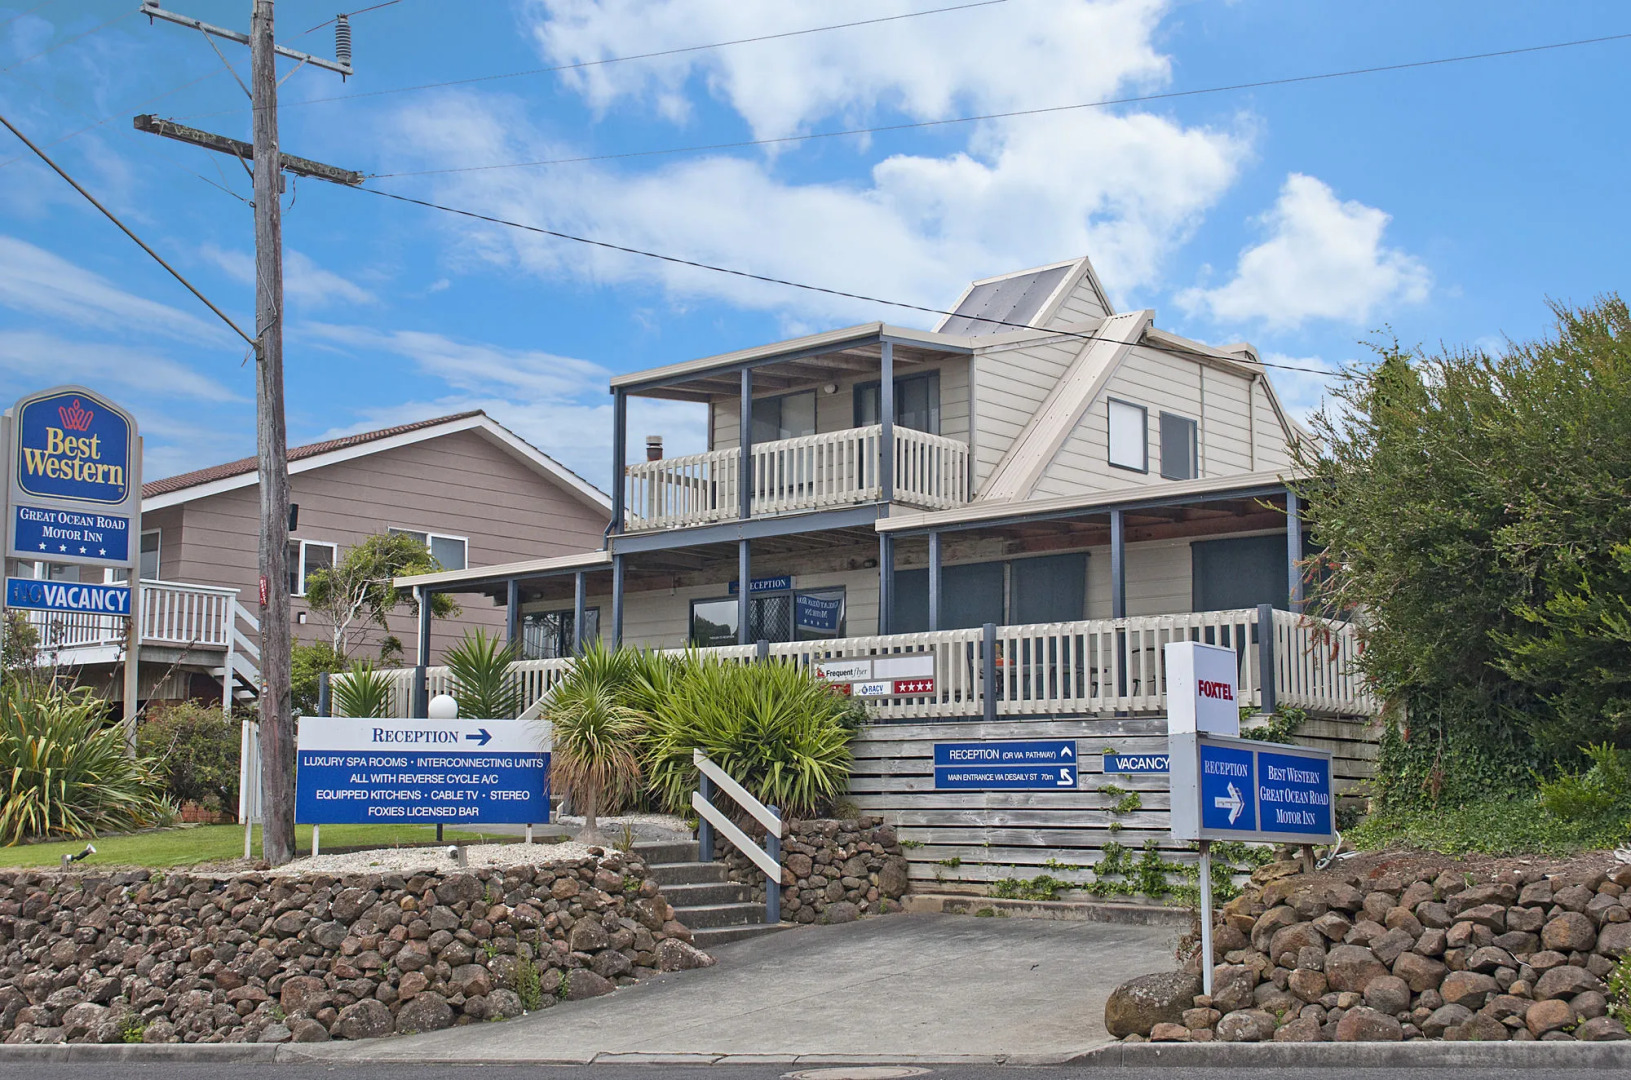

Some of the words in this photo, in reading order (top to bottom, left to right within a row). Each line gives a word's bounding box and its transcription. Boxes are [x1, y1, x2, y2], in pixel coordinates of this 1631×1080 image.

[46, 426, 101, 460] Best
[23, 447, 124, 486] Western
[20, 508, 56, 523] GREAT
[58, 512, 94, 526] OCEAN
[96, 516, 125, 530] ROAD
[42, 525, 81, 540] MOTOR
[84, 530, 103, 542] INN
[750, 579, 786, 590] ECEPTION
[43, 585, 128, 611] VACANCY
[826, 669, 853, 678] Frequent
[868, 684, 884, 692] RACV
[1198, 679, 1233, 701] FOXTEL
[371, 727, 459, 743] RECEPTION
[304, 756, 345, 767] LUXURY
[346, 757, 367, 767] SPA
[368, 757, 407, 767] ROOMS
[417, 757, 513, 768] INTERCONNECTING
[515, 758, 544, 769] UNITS
[949, 749, 1000, 760] RECEPTION
[1014, 752, 1024, 760] VIA
[1026, 751, 1056, 760] PATHWAY)
[1115, 757, 1170, 770] VACANCY
[1204, 760, 1248, 777] RECEPTION
[350, 774, 369, 784] ALL
[370, 774, 397, 784] WITH
[398, 774, 445, 784] REVERSE
[446, 774, 480, 784] CYCLE
[481, 774, 499, 784] A/C
[948, 774, 963, 782] MAIN
[963, 773, 994, 781] ENTRANCE
[995, 773, 1004, 781] VIA
[1005, 773, 1028, 781] DESAILY
[1029, 773, 1038, 781] ST
[1268, 765, 1286, 781] BEST
[1286, 767, 1320, 784] WESTERN
[316, 790, 369, 800] EQUIPPED
[370, 790, 421, 800] KITCHENS
[431, 790, 464, 800] CABLE
[465, 791, 479, 800] TV
[490, 791, 530, 800] STEREO
[1260, 786, 1284, 802] GREAT
[1285, 788, 1308, 804] OCEAN
[1309, 790, 1329, 806] ROAD
[368, 806, 405, 817] FOXIES
[406, 806, 457, 817] LICENSED
[458, 807, 479, 817] BAR
[1276, 809, 1302, 825] MOTOR
[1302, 810, 1316, 825] INN
